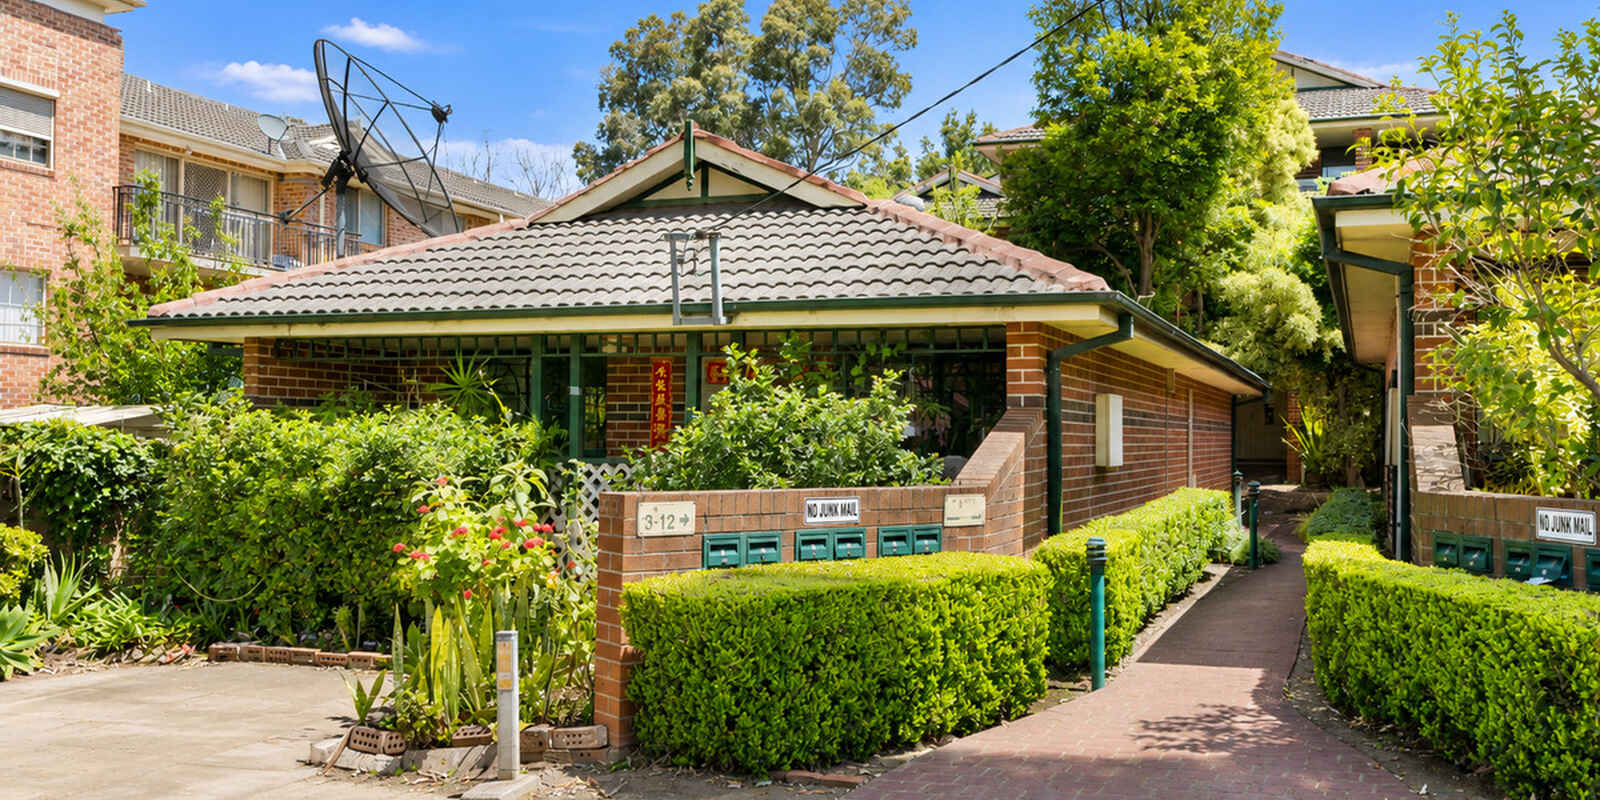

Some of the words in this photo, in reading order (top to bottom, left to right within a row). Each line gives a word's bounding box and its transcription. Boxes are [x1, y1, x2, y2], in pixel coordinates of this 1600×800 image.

[807, 503, 818, 518] NO
[819, 503, 839, 517] JUNK
[840, 502, 857, 517] MAIL
[645, 514, 675, 530] 3-12
[1539, 513, 1549, 531] NO
[1551, 515, 1571, 533] JUNK
[1573, 516, 1592, 536] MAIL
